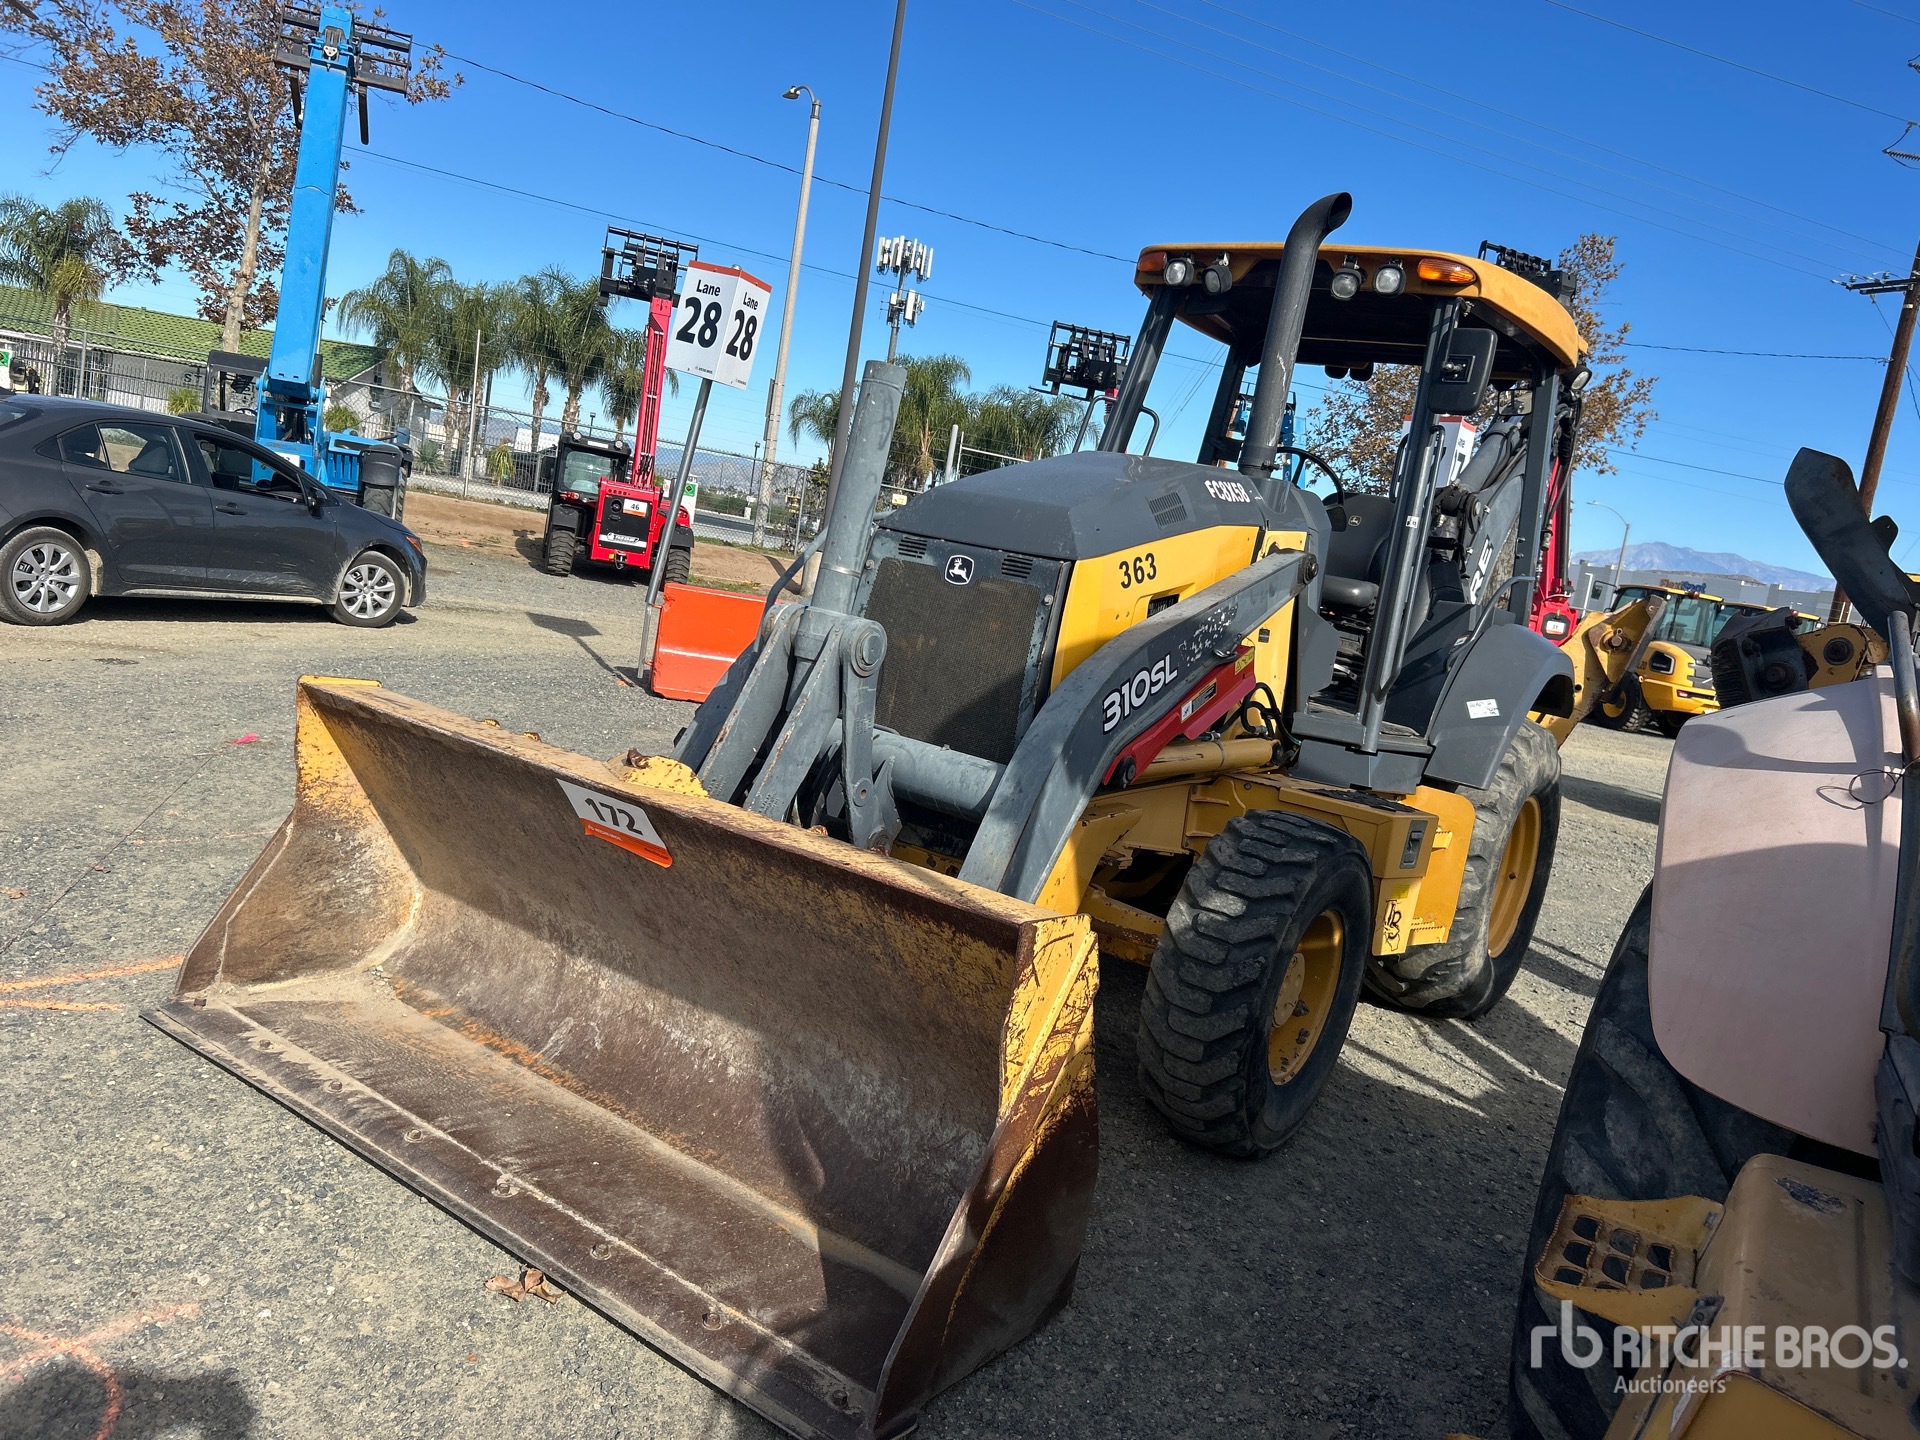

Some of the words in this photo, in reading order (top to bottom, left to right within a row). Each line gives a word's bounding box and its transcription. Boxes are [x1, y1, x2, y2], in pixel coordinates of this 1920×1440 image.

[695, 279, 721, 297] Lane
[742, 292, 759, 311] Lane
[676, 296, 722, 349] 28
[726, 309, 758, 361] 28
[1118, 552, 1157, 589] 363
[1103, 653, 1178, 734] 310SL
[584, 797, 644, 836] 172
